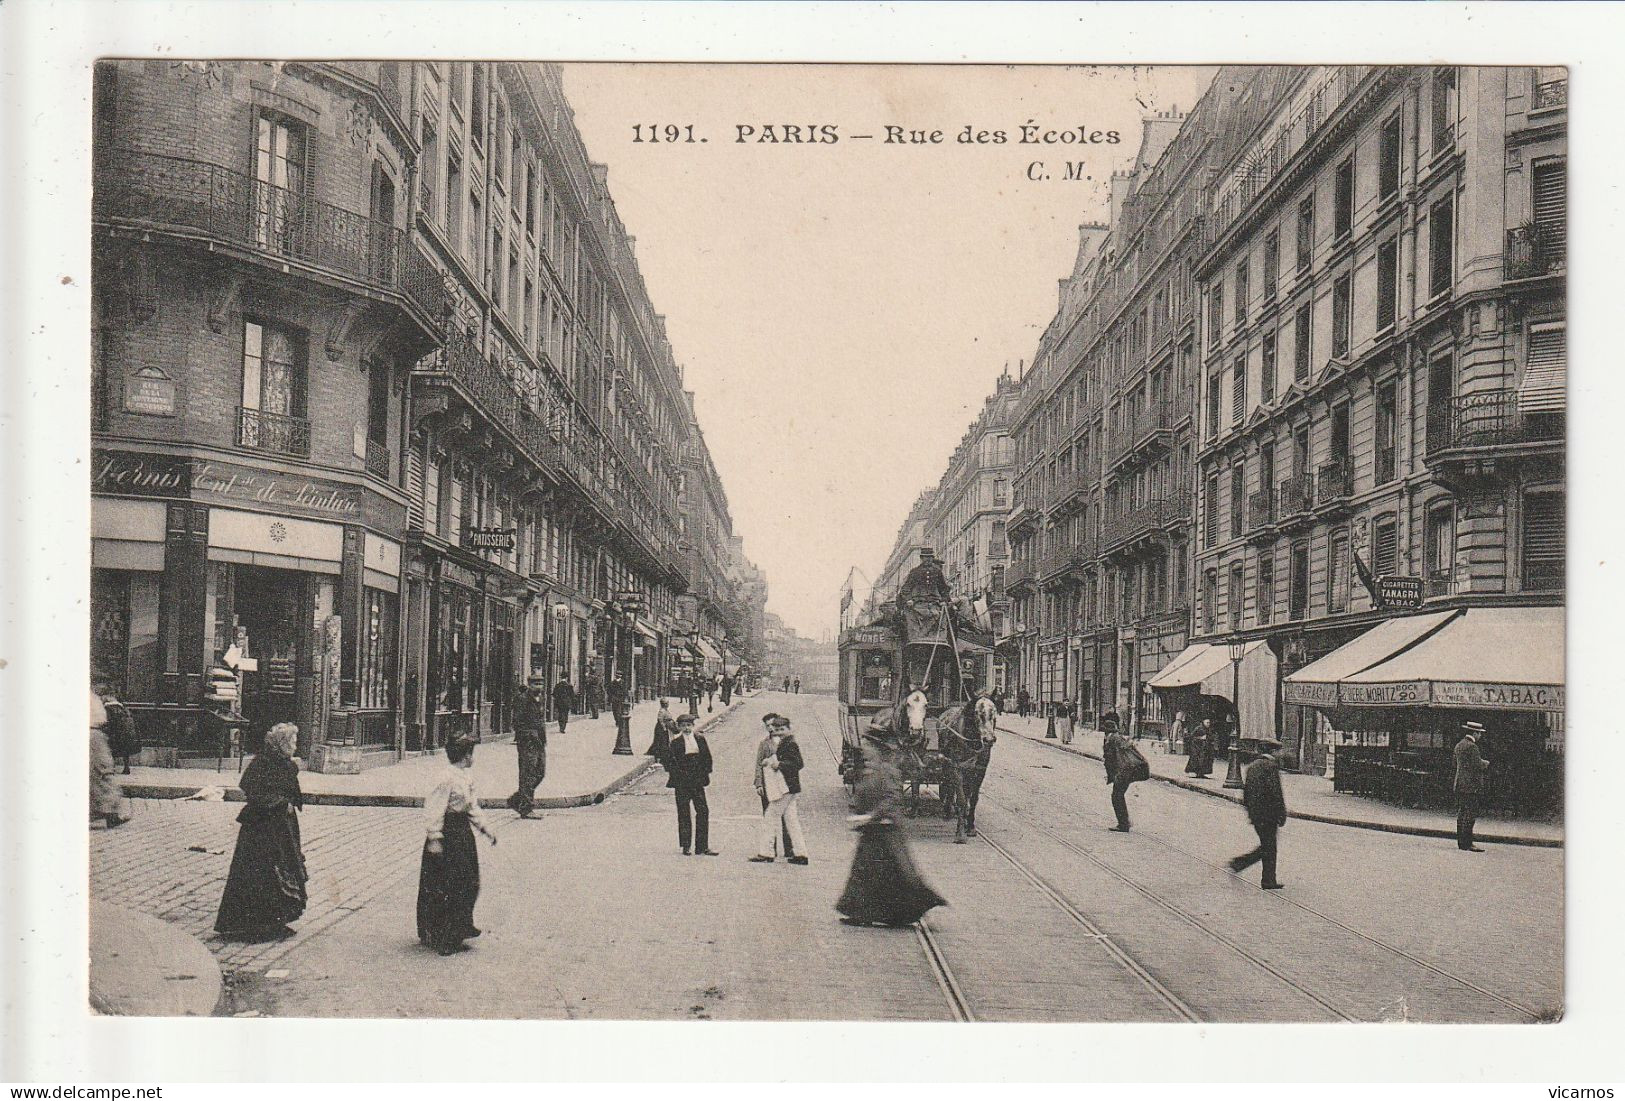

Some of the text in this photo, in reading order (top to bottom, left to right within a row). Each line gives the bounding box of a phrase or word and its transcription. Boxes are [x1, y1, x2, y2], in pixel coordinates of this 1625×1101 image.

[473, 533, 511, 547] PATISSERIE
[1381, 588, 1419, 599] TANAGRA
[1384, 599, 1415, 607] TABAC
[1483, 688, 1547, 705] TABAC
